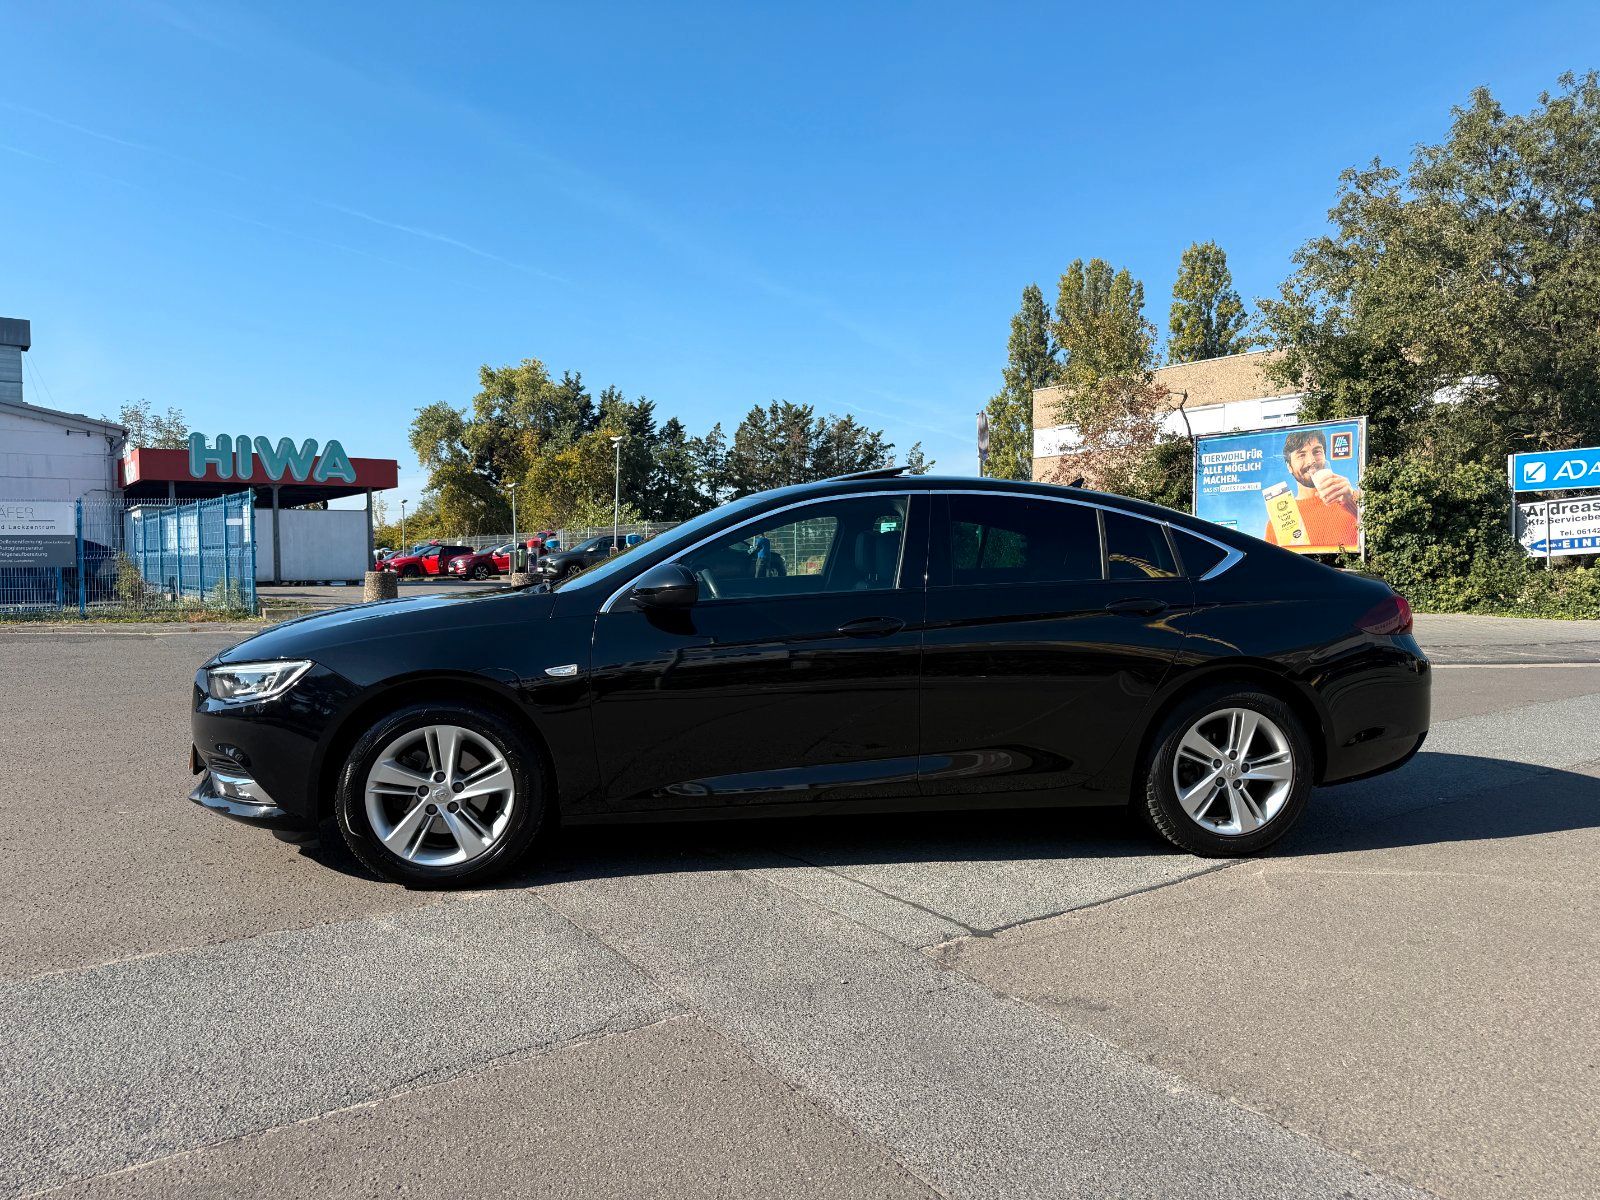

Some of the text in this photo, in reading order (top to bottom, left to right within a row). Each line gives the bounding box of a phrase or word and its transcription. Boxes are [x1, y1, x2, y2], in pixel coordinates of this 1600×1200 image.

[1203, 448, 1263, 464] TIERWOHL FÜR
[1334, 446, 1349, 454] ALDI
[188, 432, 357, 484] HIWA
[1203, 461, 1262, 475] ALLE MÖGLICH
[1203, 474, 1240, 485] MACHEN.
[1560, 529, 1574, 537] Tel.
